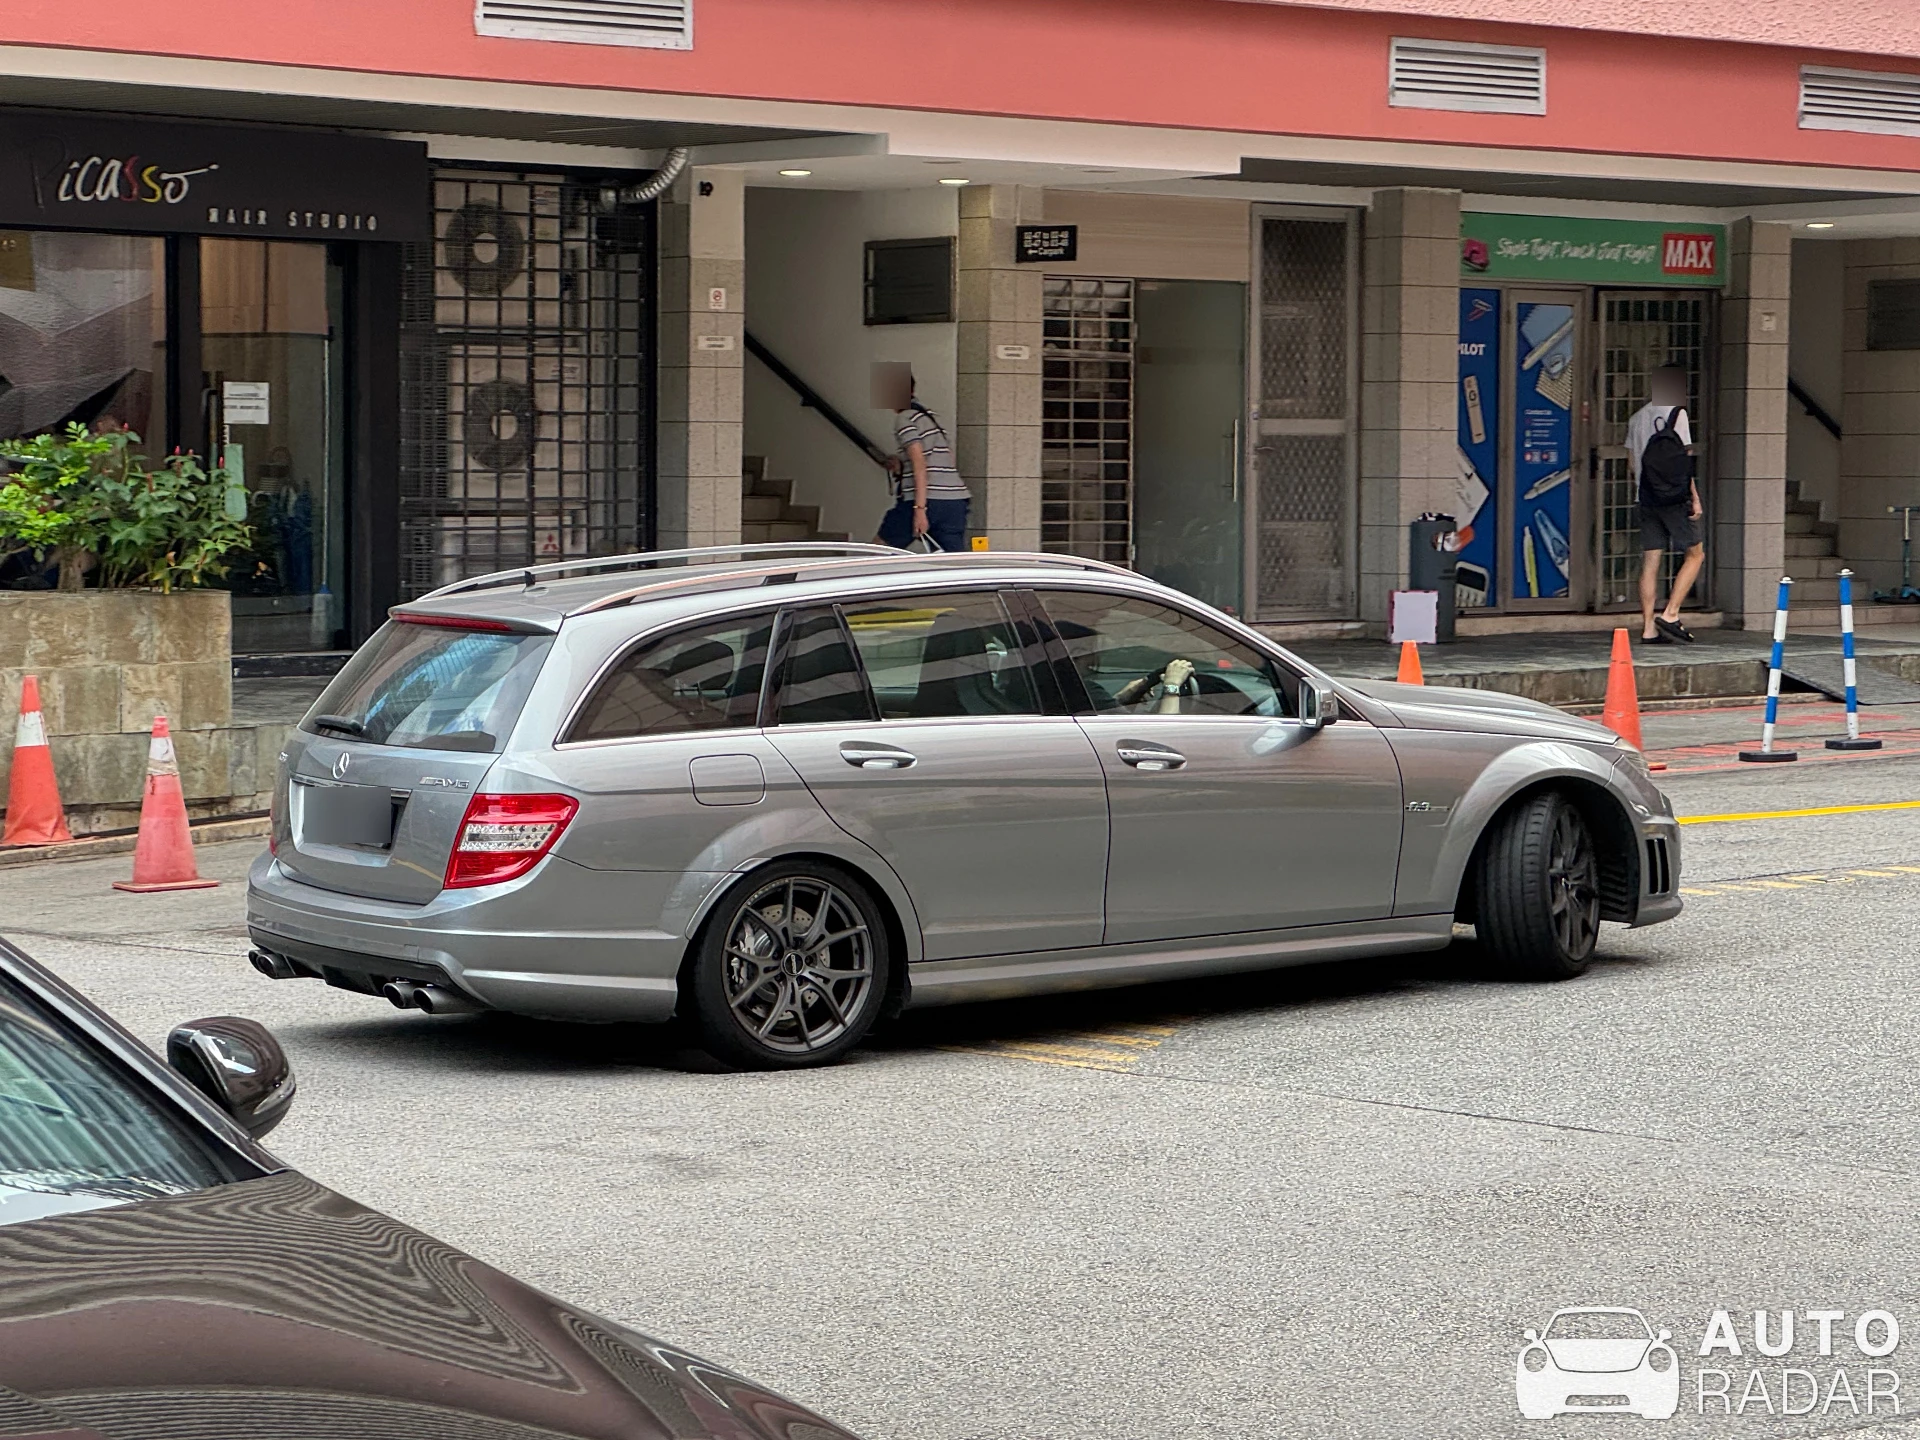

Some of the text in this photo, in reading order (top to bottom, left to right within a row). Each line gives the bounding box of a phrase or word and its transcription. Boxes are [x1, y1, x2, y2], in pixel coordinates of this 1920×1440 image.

[208, 207, 378, 231] HAIR STUDIO
[1664, 239, 1712, 269] MAX
[433, 778, 470, 789] AMG
